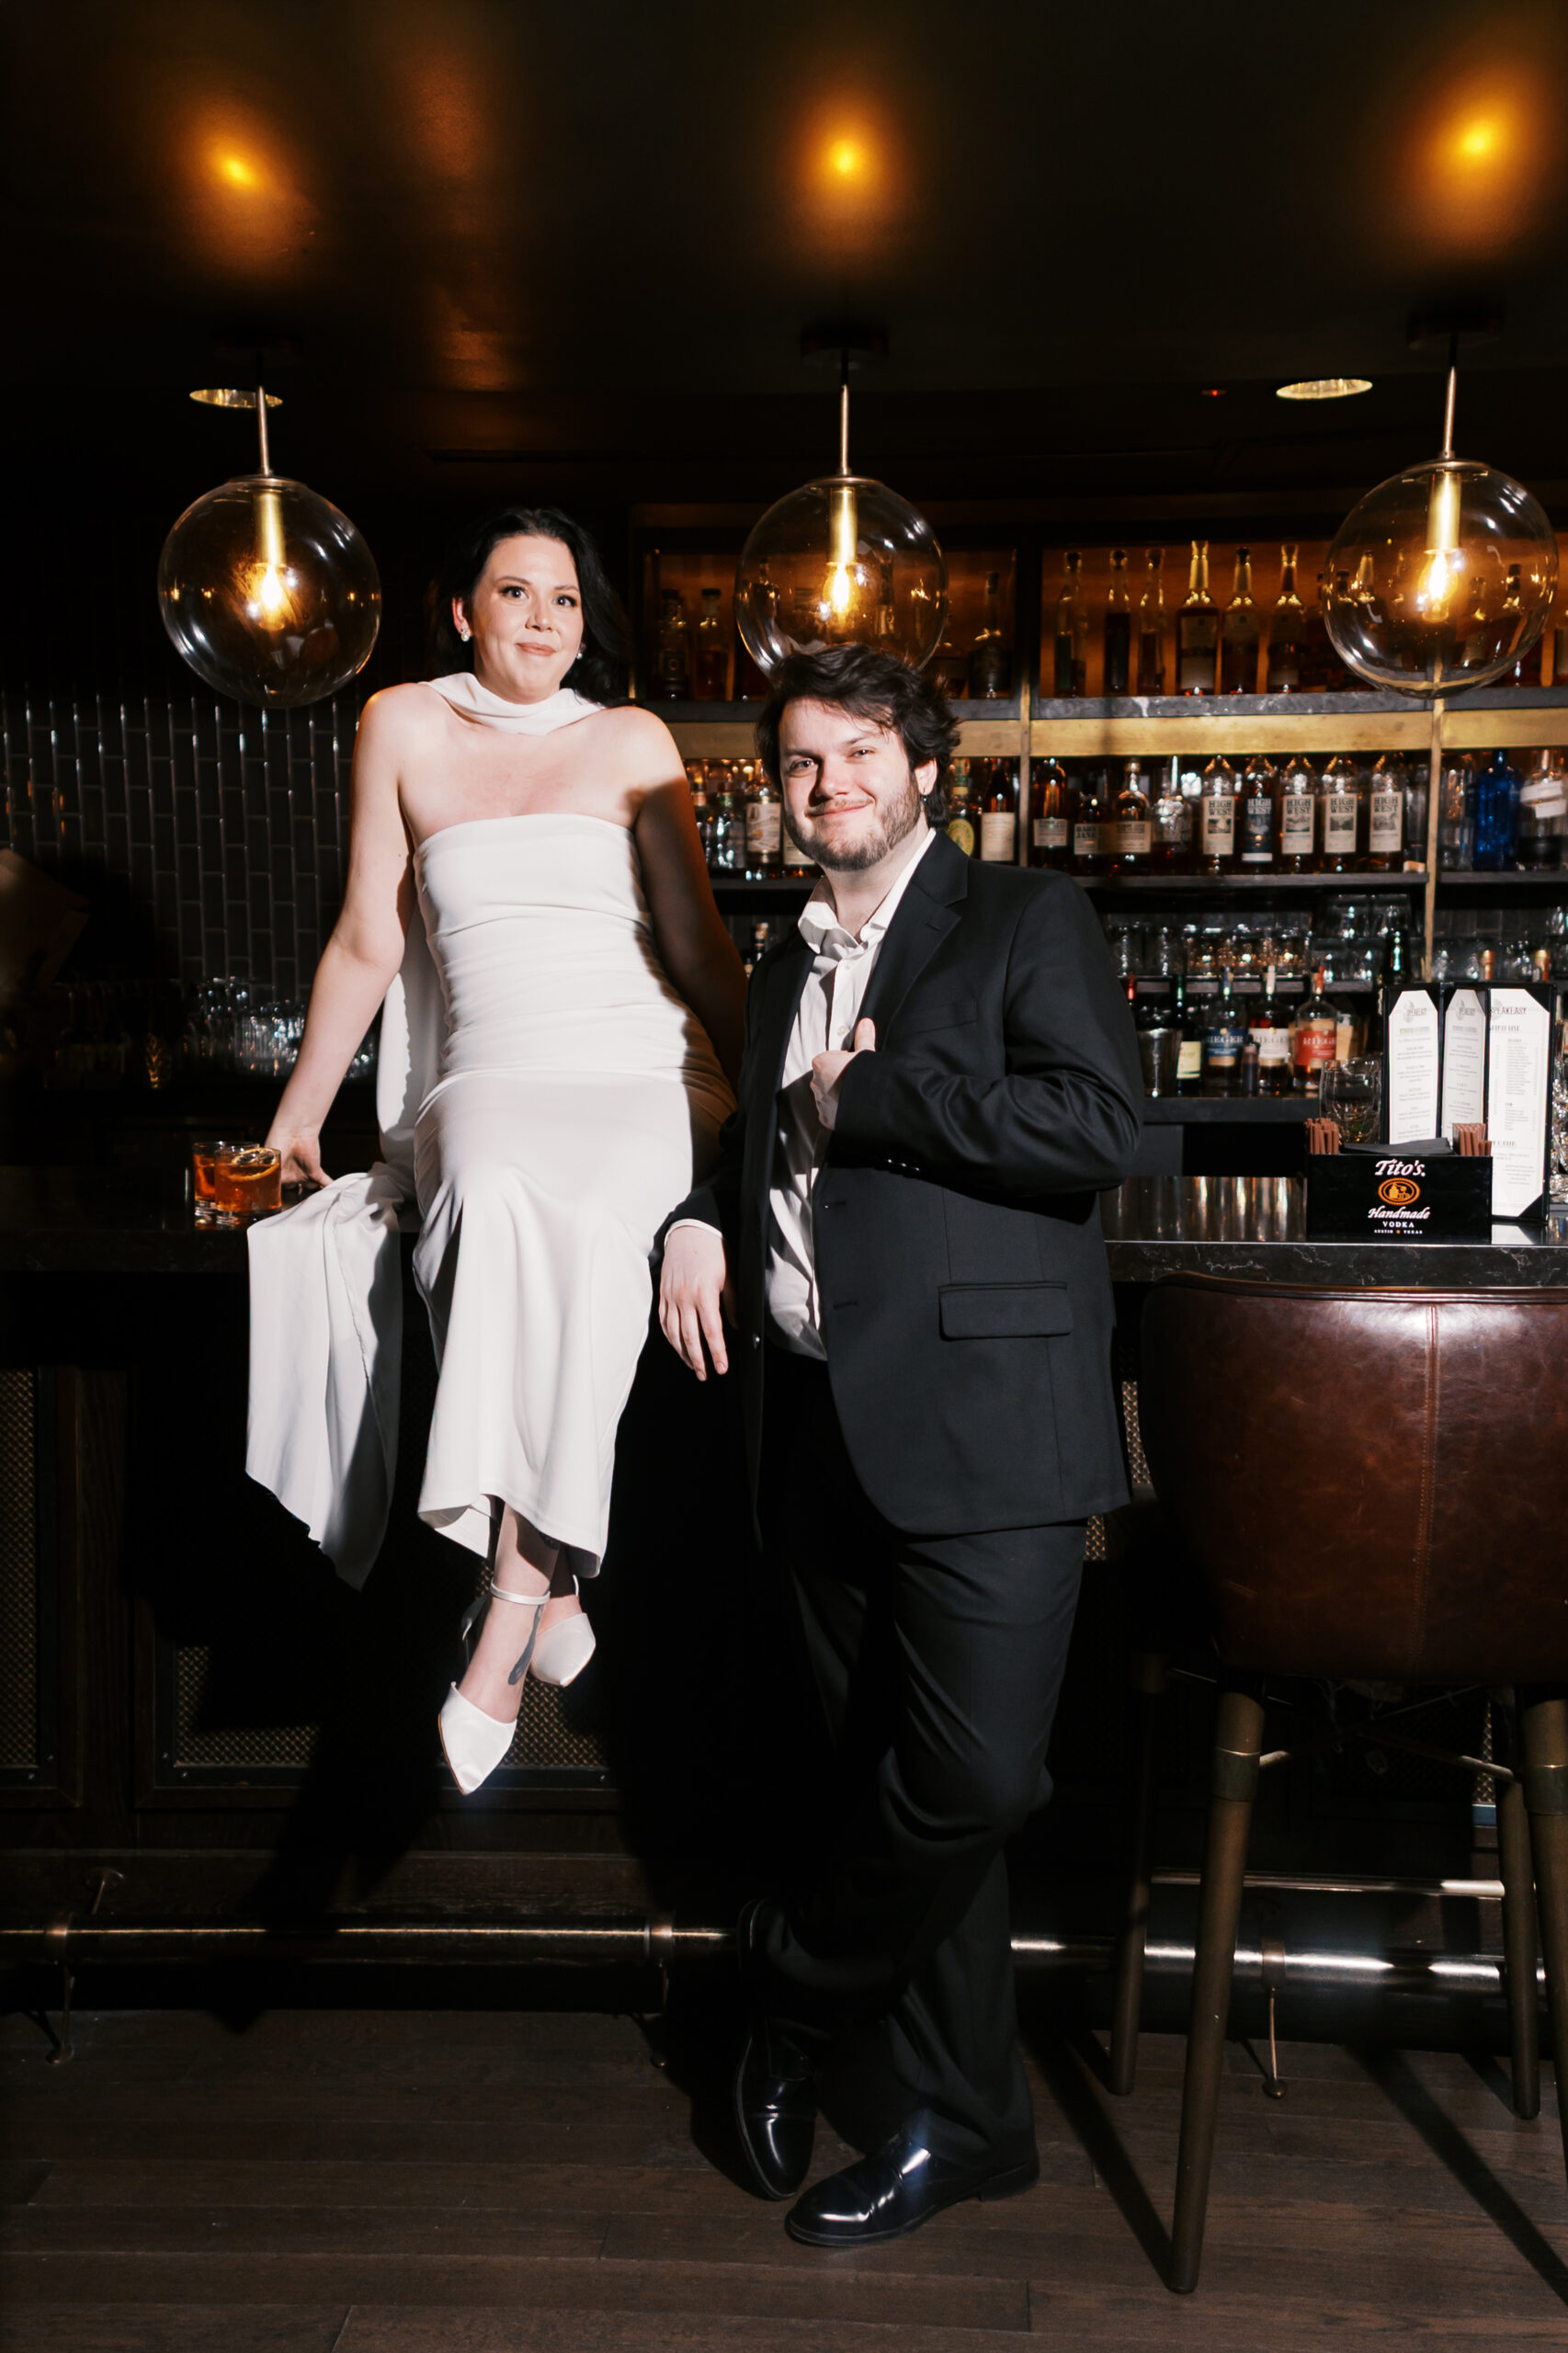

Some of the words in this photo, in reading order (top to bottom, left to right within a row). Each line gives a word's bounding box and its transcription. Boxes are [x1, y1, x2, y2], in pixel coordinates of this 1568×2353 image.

[1247, 799, 1272, 807] HIGH
[1331, 798, 1354, 806] HIGH
[1287, 806, 1311, 814] WEST
[1375, 804, 1397, 813] WEST
[1368, 1205, 1431, 1220] Handmade
